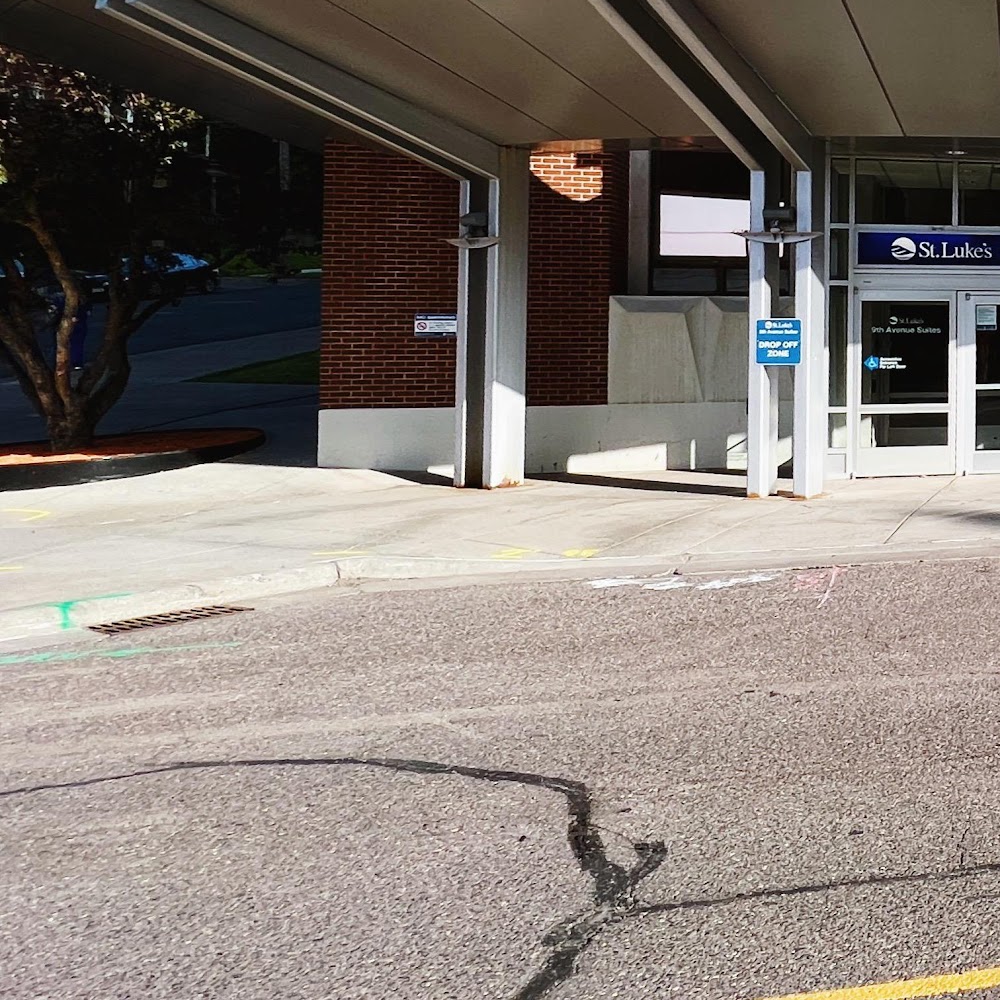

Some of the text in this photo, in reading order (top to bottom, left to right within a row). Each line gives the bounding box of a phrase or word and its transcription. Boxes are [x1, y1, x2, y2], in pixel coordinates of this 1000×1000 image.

[871, 326, 942, 334] 9th Avenue Suites
[758, 340, 799, 349] DROP OFF
[767, 349, 790, 358] ZONE
